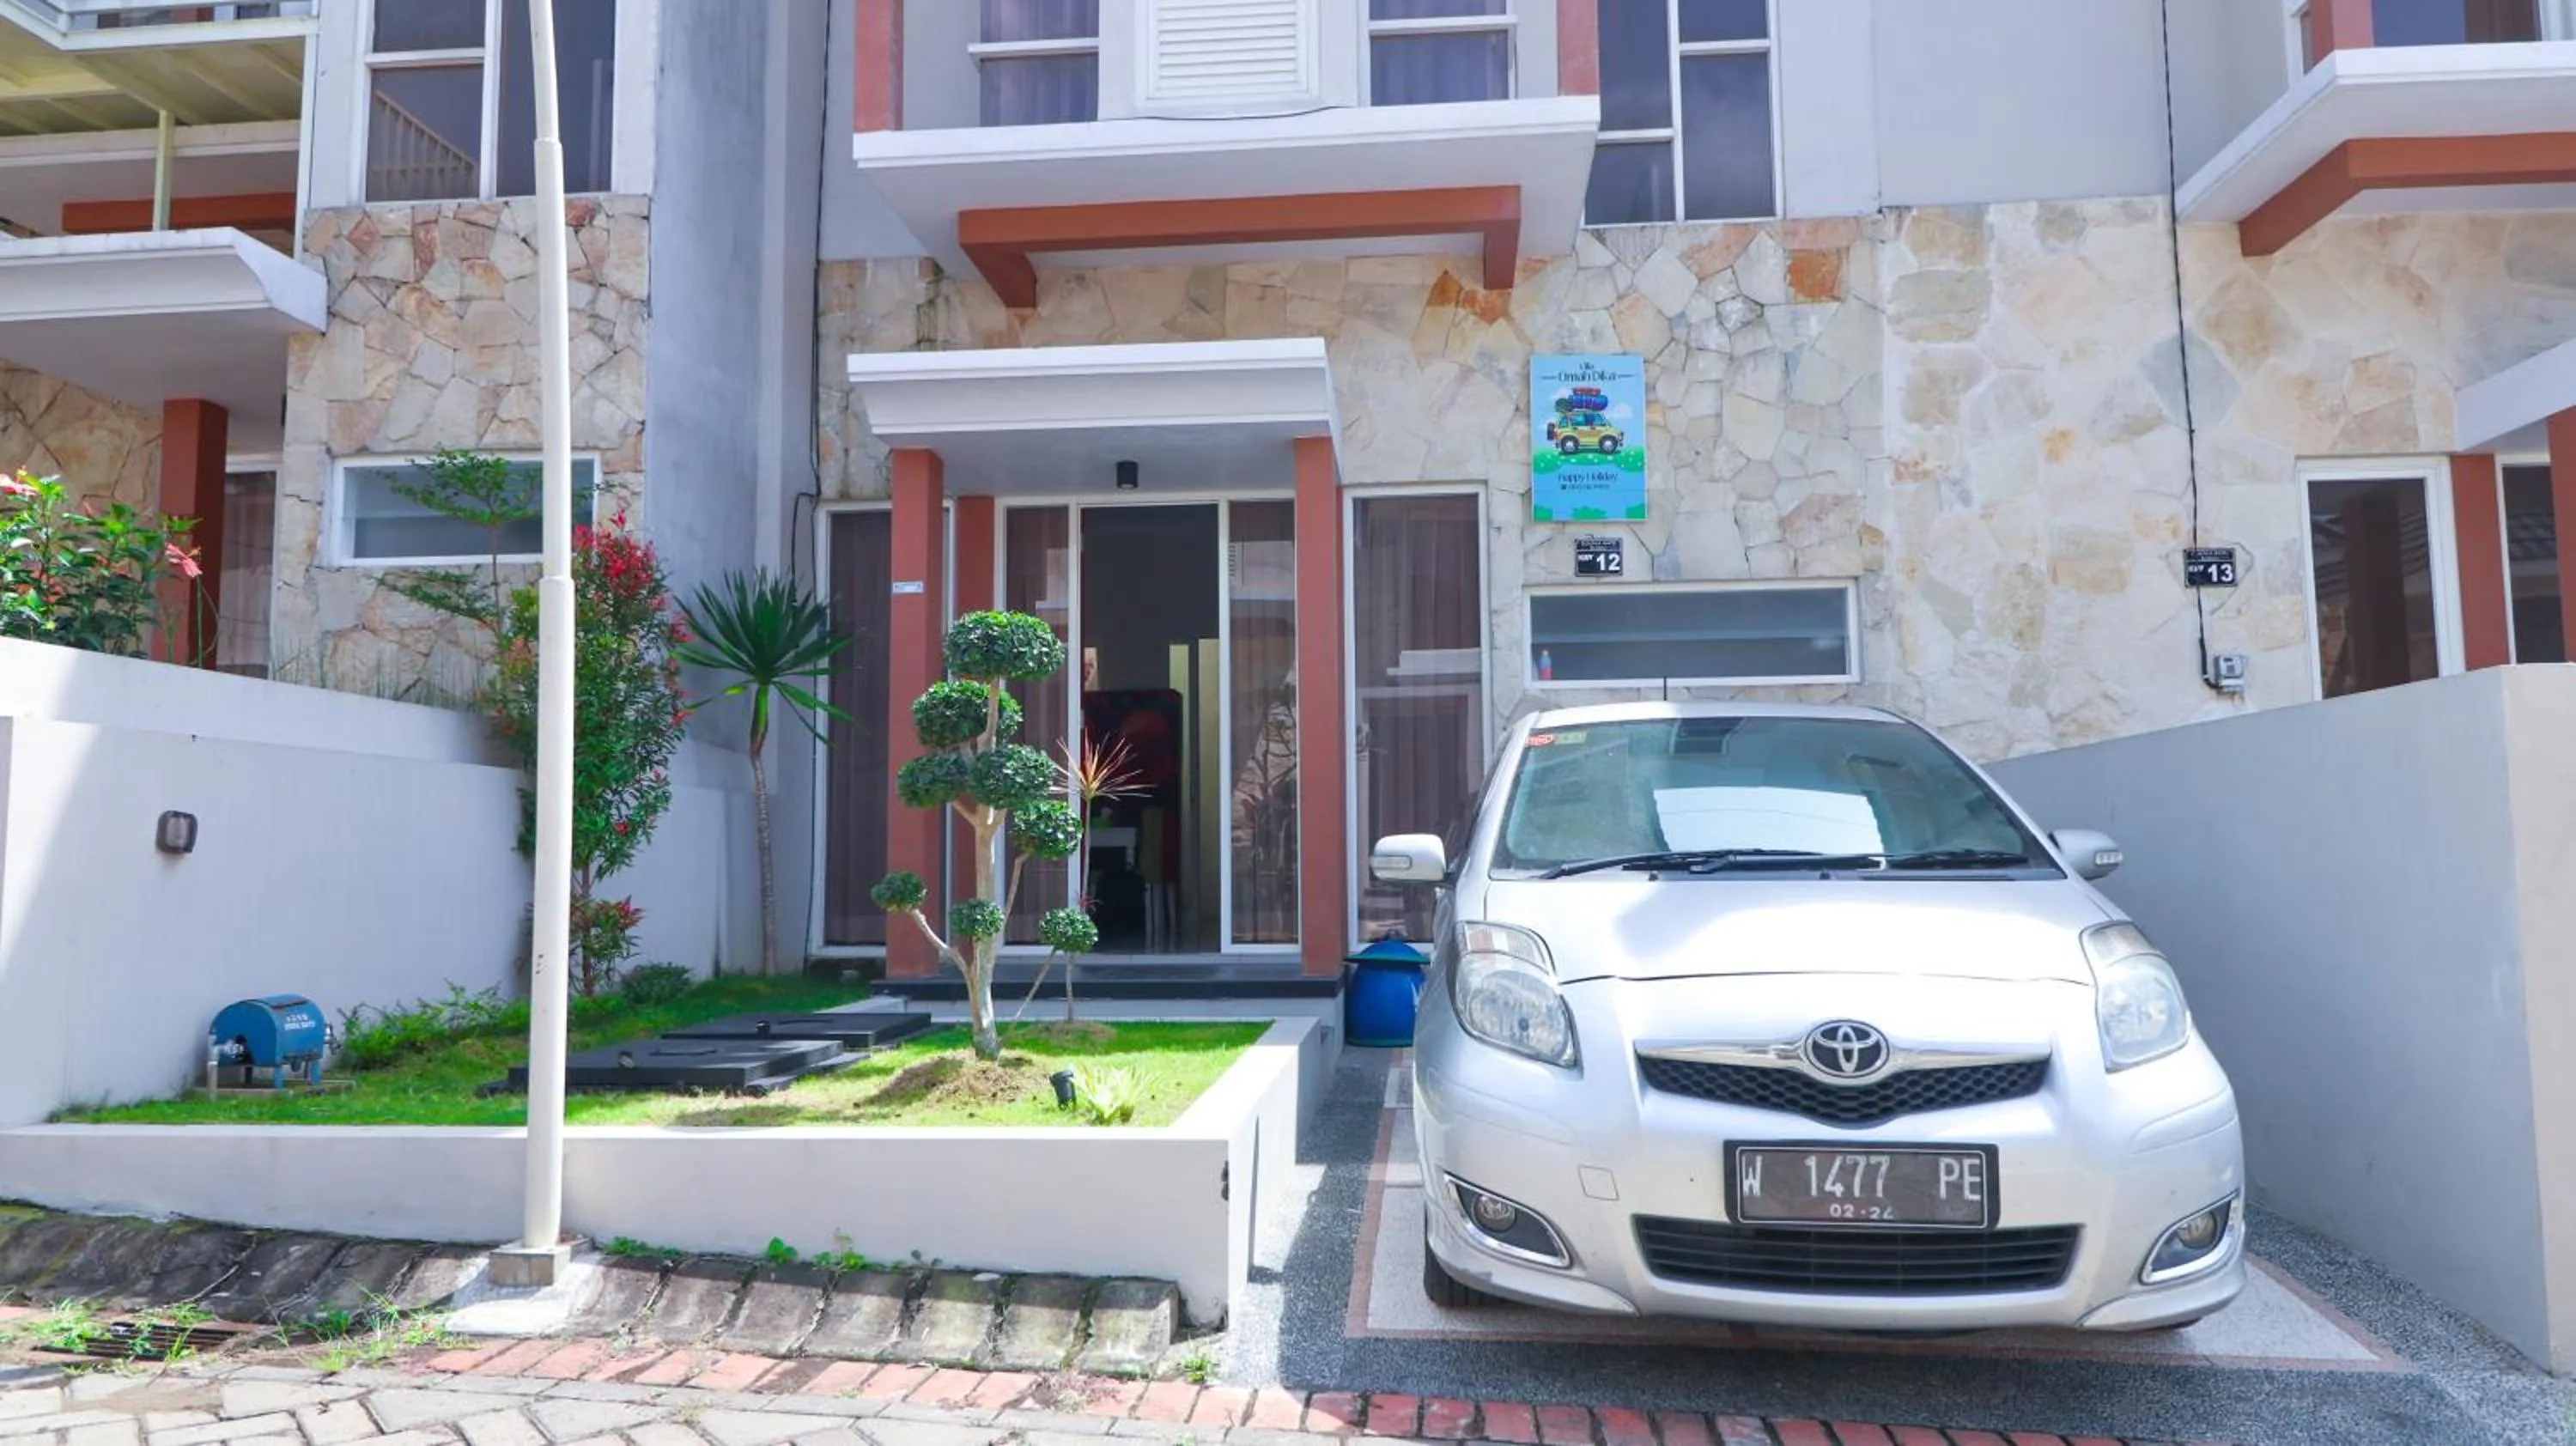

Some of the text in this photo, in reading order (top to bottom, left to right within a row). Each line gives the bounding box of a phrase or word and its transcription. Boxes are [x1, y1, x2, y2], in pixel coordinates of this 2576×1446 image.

[1596, 552, 1620, 571] 12
[2208, 562, 2233, 582] 13
[1741, 1155, 1982, 1201] W 1477 PE
